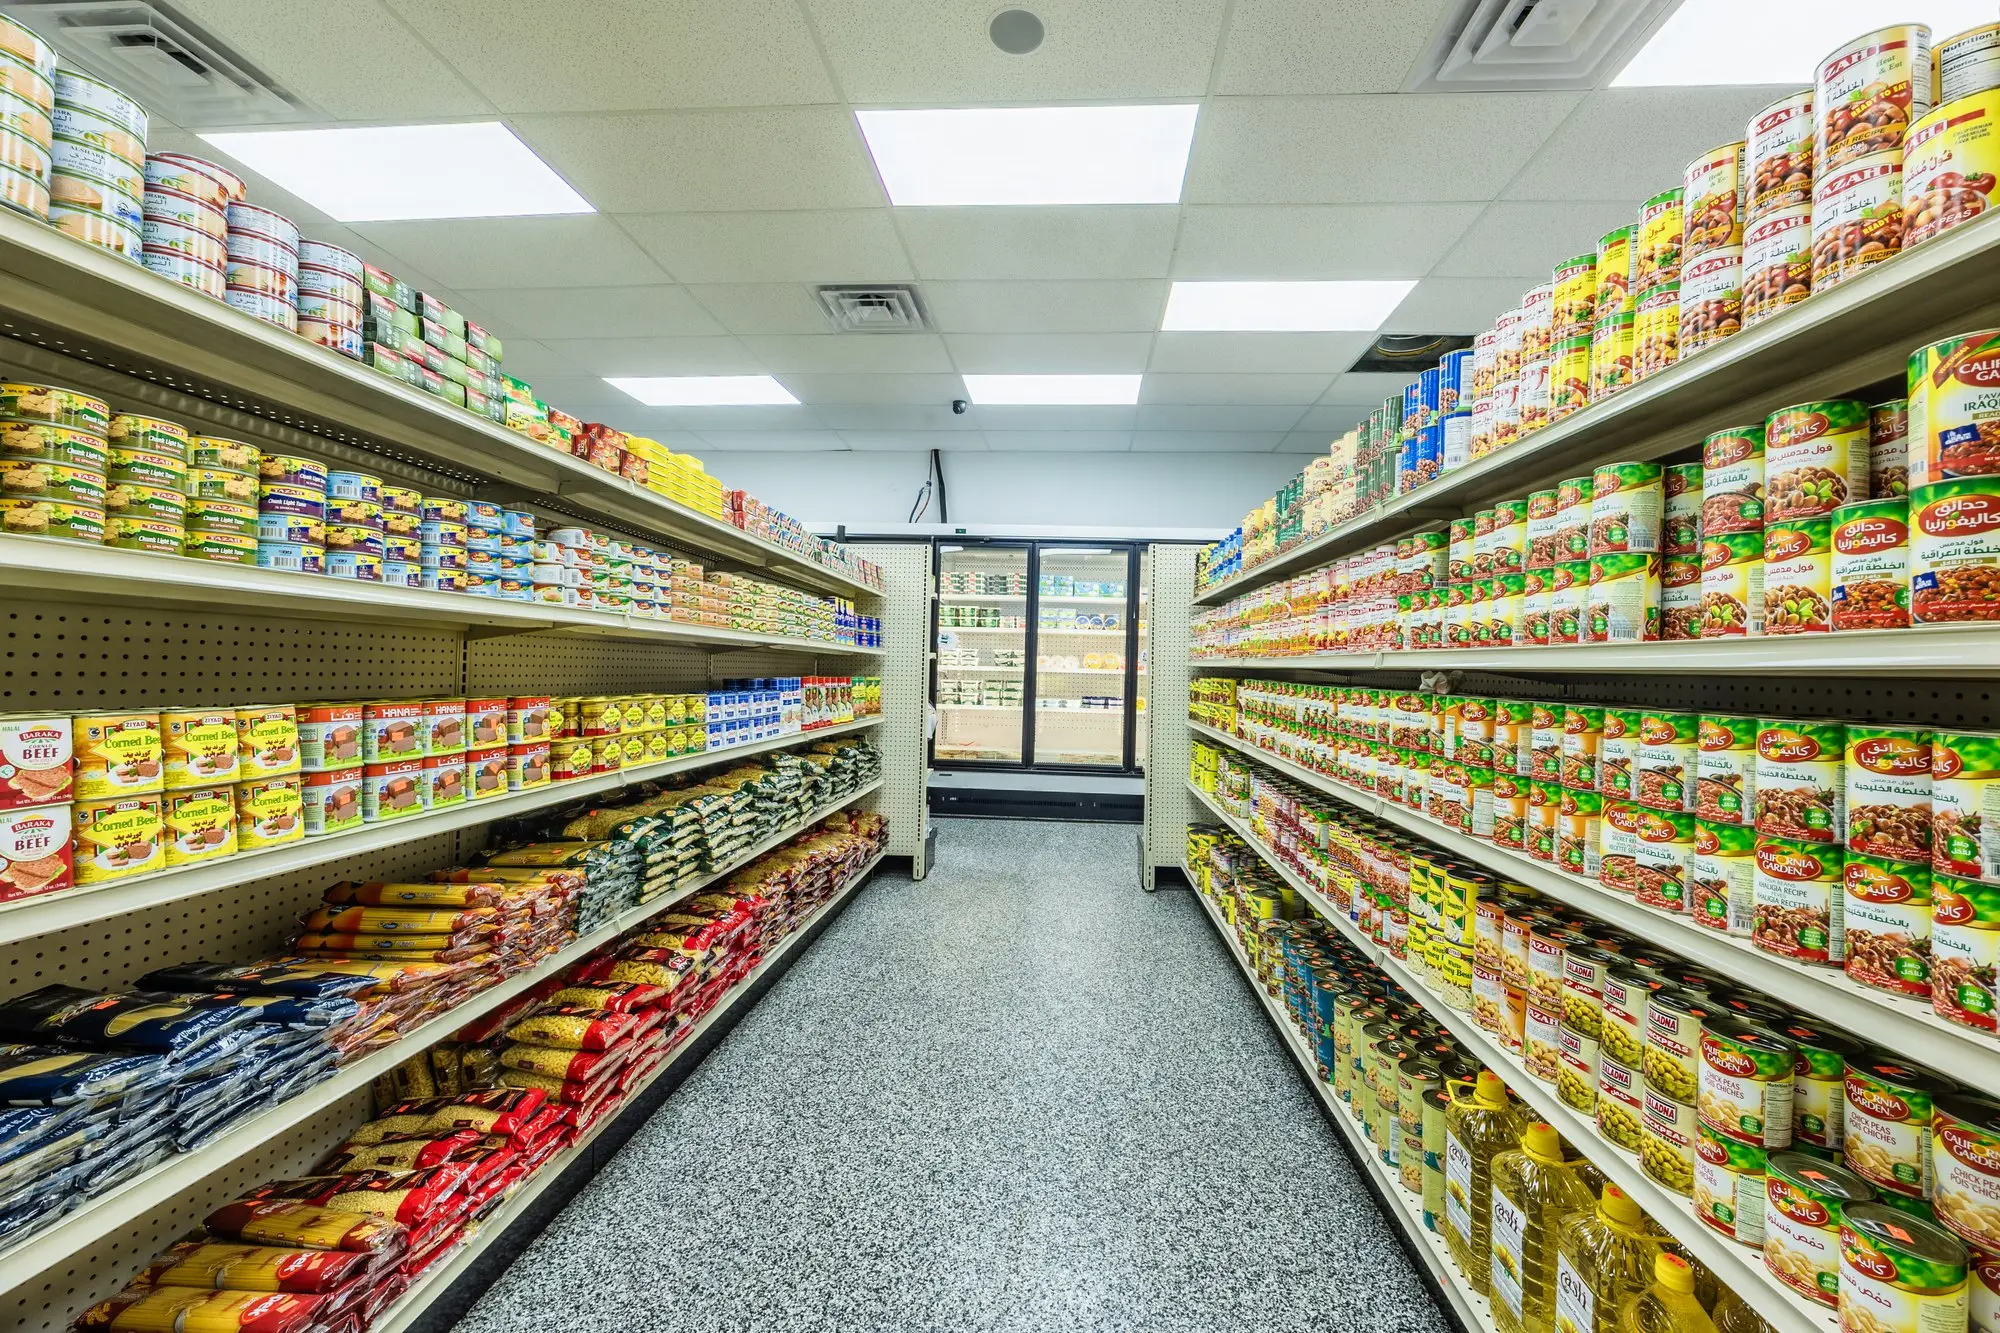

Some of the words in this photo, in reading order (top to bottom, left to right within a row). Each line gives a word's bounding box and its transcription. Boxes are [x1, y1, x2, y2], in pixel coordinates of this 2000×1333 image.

[1942, 31, 1992, 54] Nutrition
[1876, 56, 1895, 68] Heat
[1888, 62, 1903, 72] Eat
[1942, 58, 1978, 75] Calories
[1851, 94, 1878, 117] READY
[1880, 88, 1891, 100] TO
[1893, 81, 1908, 93] EAT
[1851, 128, 1886, 144] RECIPE
[1788, 150, 1812, 167] READY
[1692, 204, 1710, 222] READY
[1720, 192, 1734, 202] EAT
[1862, 216, 1890, 235] READY
[1891, 212, 1902, 222] TO
[1938, 209, 1973, 228] PEAS
[1863, 250, 1898, 262] RECIPE
[1788, 262, 1811, 278] READY
[382, 708, 410, 717] HANA
[436, 706, 458, 714] HANA
[126, 720, 146, 728] ZIYAD
[22, 730, 59, 740] BARAKA
[185, 733, 218, 742] Corned
[250, 728, 279, 738] Corned
[104, 737, 142, 749] Corned
[1868, 742, 1920, 756] حدائق
[23, 747, 59, 760] BEEF
[194, 791, 212, 799] ZIYAD
[252, 796, 282, 806] Corned
[118, 802, 138, 810] ZIYAD
[173, 808, 209, 820] Corned
[15, 820, 52, 832] BARAKA
[93, 820, 134, 833] Corned
[15, 836, 51, 850] BEEF
[1758, 850, 1815, 870] CALIFORNIA
[1762, 860, 1803, 876] GARDEN
[1784, 888, 1808, 898] RECIPE
[1780, 898, 1810, 911] RECETTE
[1703, 1042, 1750, 1068] CALIFORNIA
[1708, 1053, 1740, 1073] GARDEN
[1706, 1069, 1722, 1086] CHICK
[1724, 1079, 1740, 1091] PEAS
[1716, 1083, 1745, 1100] CHICHES
[1846, 1079, 1902, 1111] CALIFORNIA
[1850, 1093, 1890, 1116] GARDEN
[1851, 1111, 1870, 1126] CHICK
[1871, 1122, 1891, 1136] PEAS
[1850, 1118, 1862, 1132] POIS
[1862, 1126, 1896, 1146] CHICHES
[1950, 1173, 1970, 1189] POIS
[1954, 1166, 1980, 1184] CHICK
